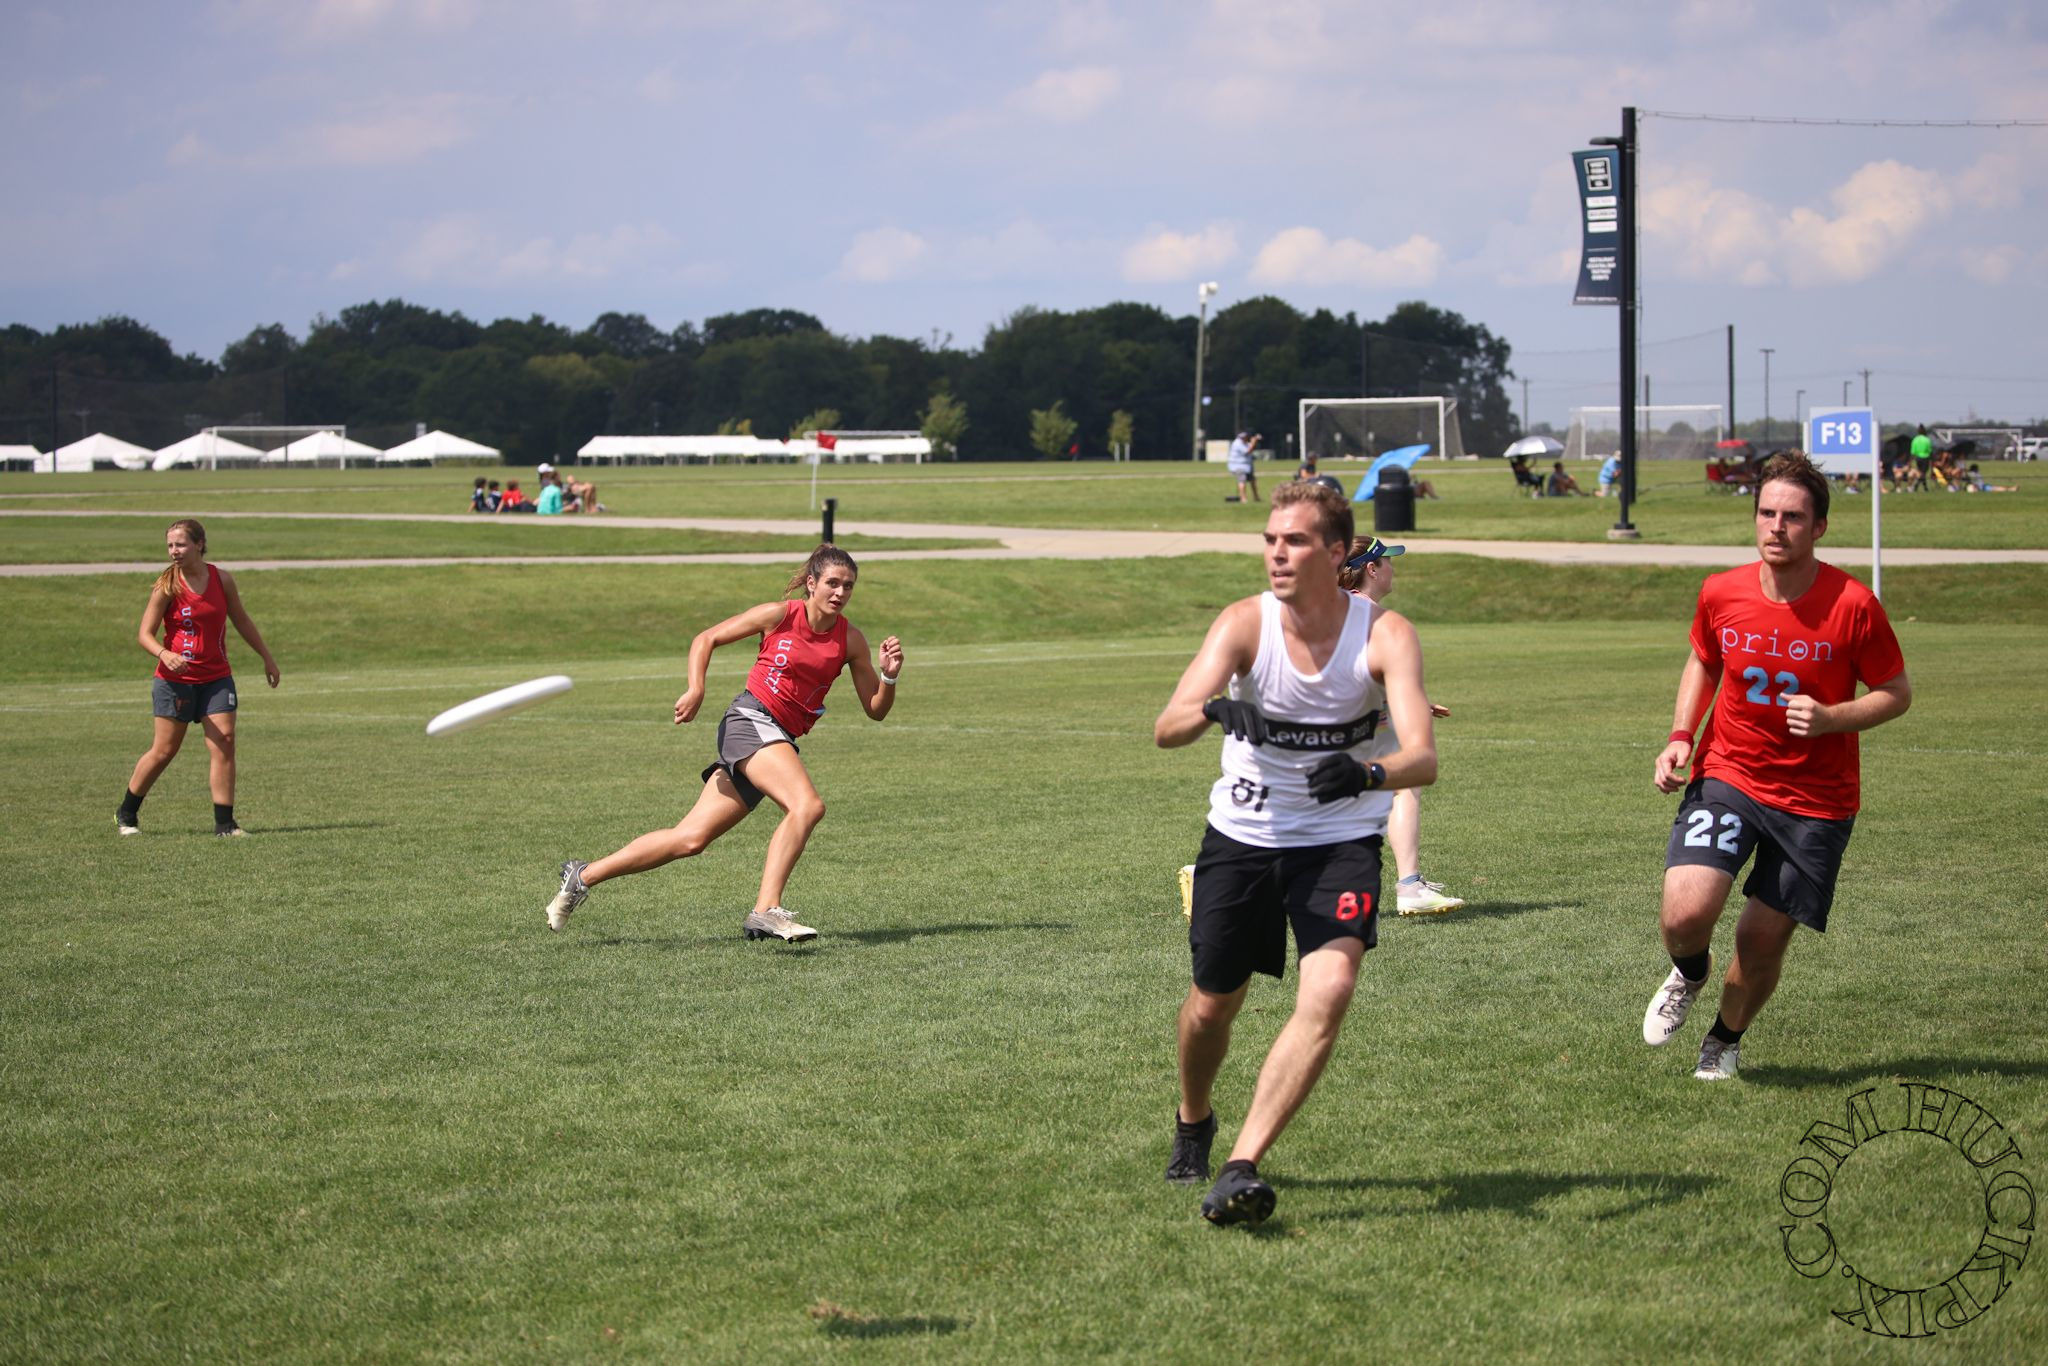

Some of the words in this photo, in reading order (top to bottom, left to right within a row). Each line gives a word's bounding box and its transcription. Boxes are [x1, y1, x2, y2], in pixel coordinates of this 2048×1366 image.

[1821, 422, 1862, 445] F13
[1721, 627, 1833, 661] prion
[1743, 666, 1799, 707] 22
[1684, 809, 1742, 855] 22
[1336, 891, 1371, 921] 81
